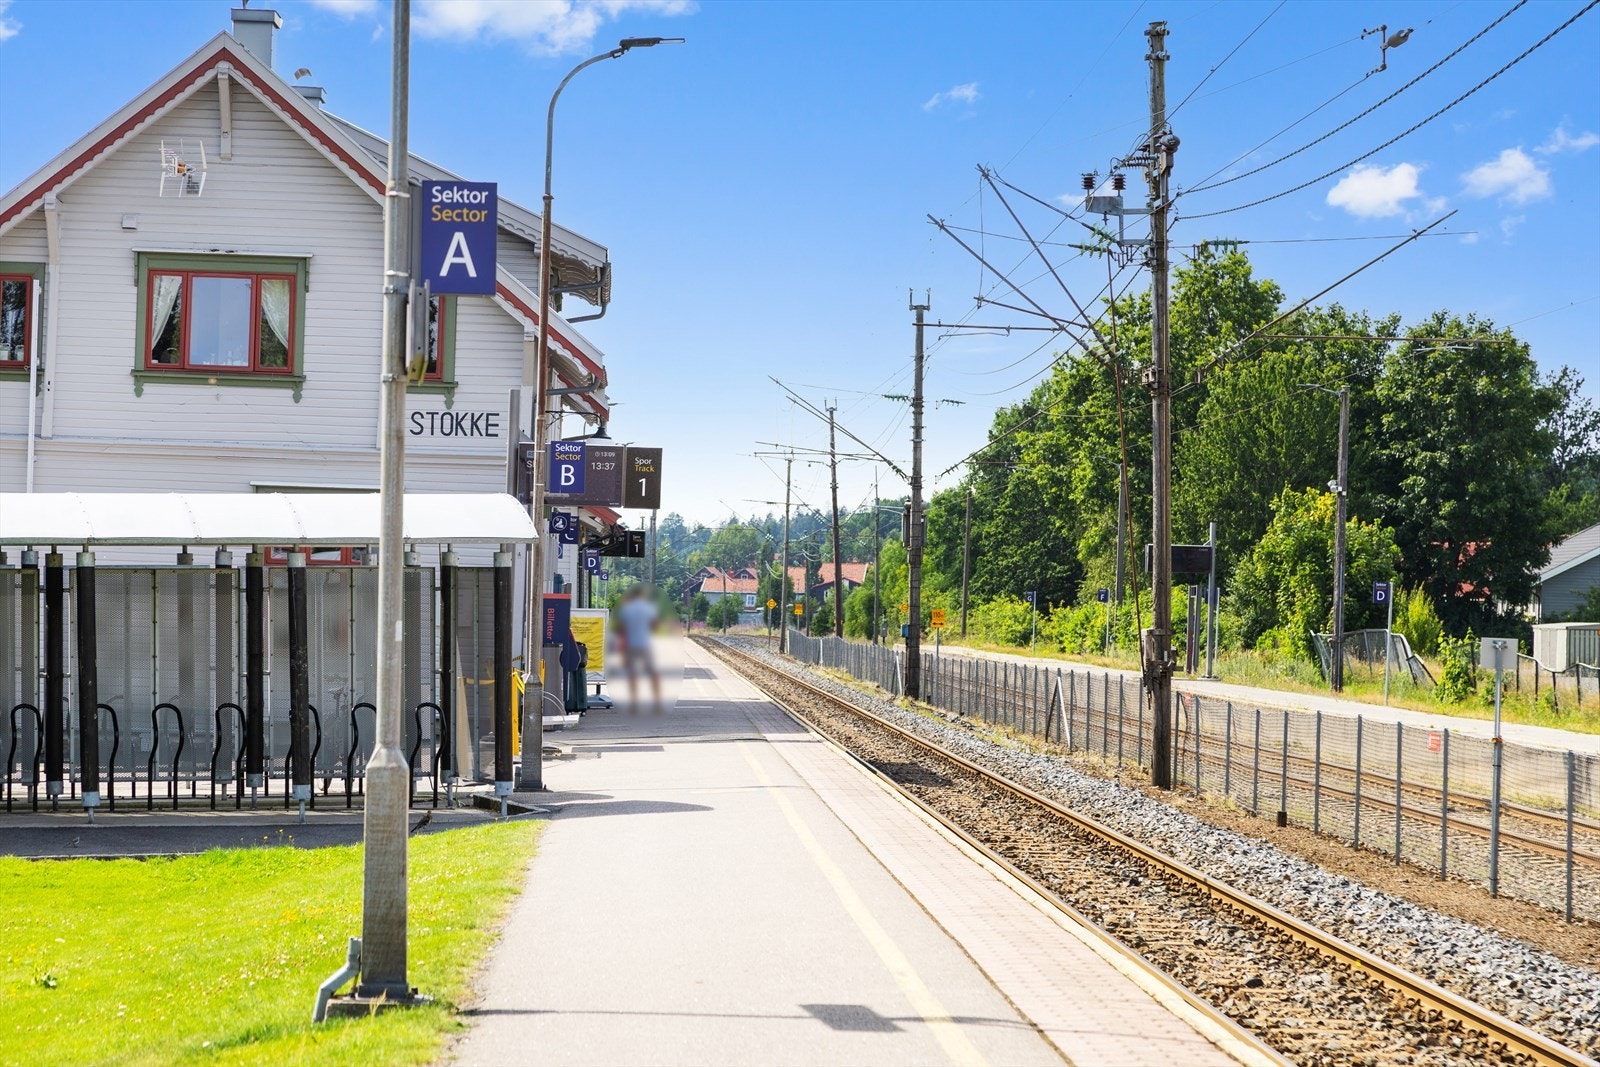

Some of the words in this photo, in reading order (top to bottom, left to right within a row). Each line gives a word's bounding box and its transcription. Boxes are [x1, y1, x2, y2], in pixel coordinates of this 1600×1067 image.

[431, 185, 489, 204] Sektor
[431, 204, 489, 222] Sector
[439, 231, 477, 278] A
[409, 411, 500, 438] STOKKE
[555, 443, 582, 453] Sektor
[555, 452, 582, 461] Sector
[634, 456, 652, 466] Spor
[591, 462, 616, 471] 13:37
[634, 464, 655, 473] Track
[560, 464, 576, 486] B
[638, 477, 647, 497] 1
[634, 543, 640, 553] 1
[588, 557, 597, 568] D
[1100, 593, 1106, 601] F
[1377, 591, 1385, 601] D
[547, 608, 555, 640] Billetter
